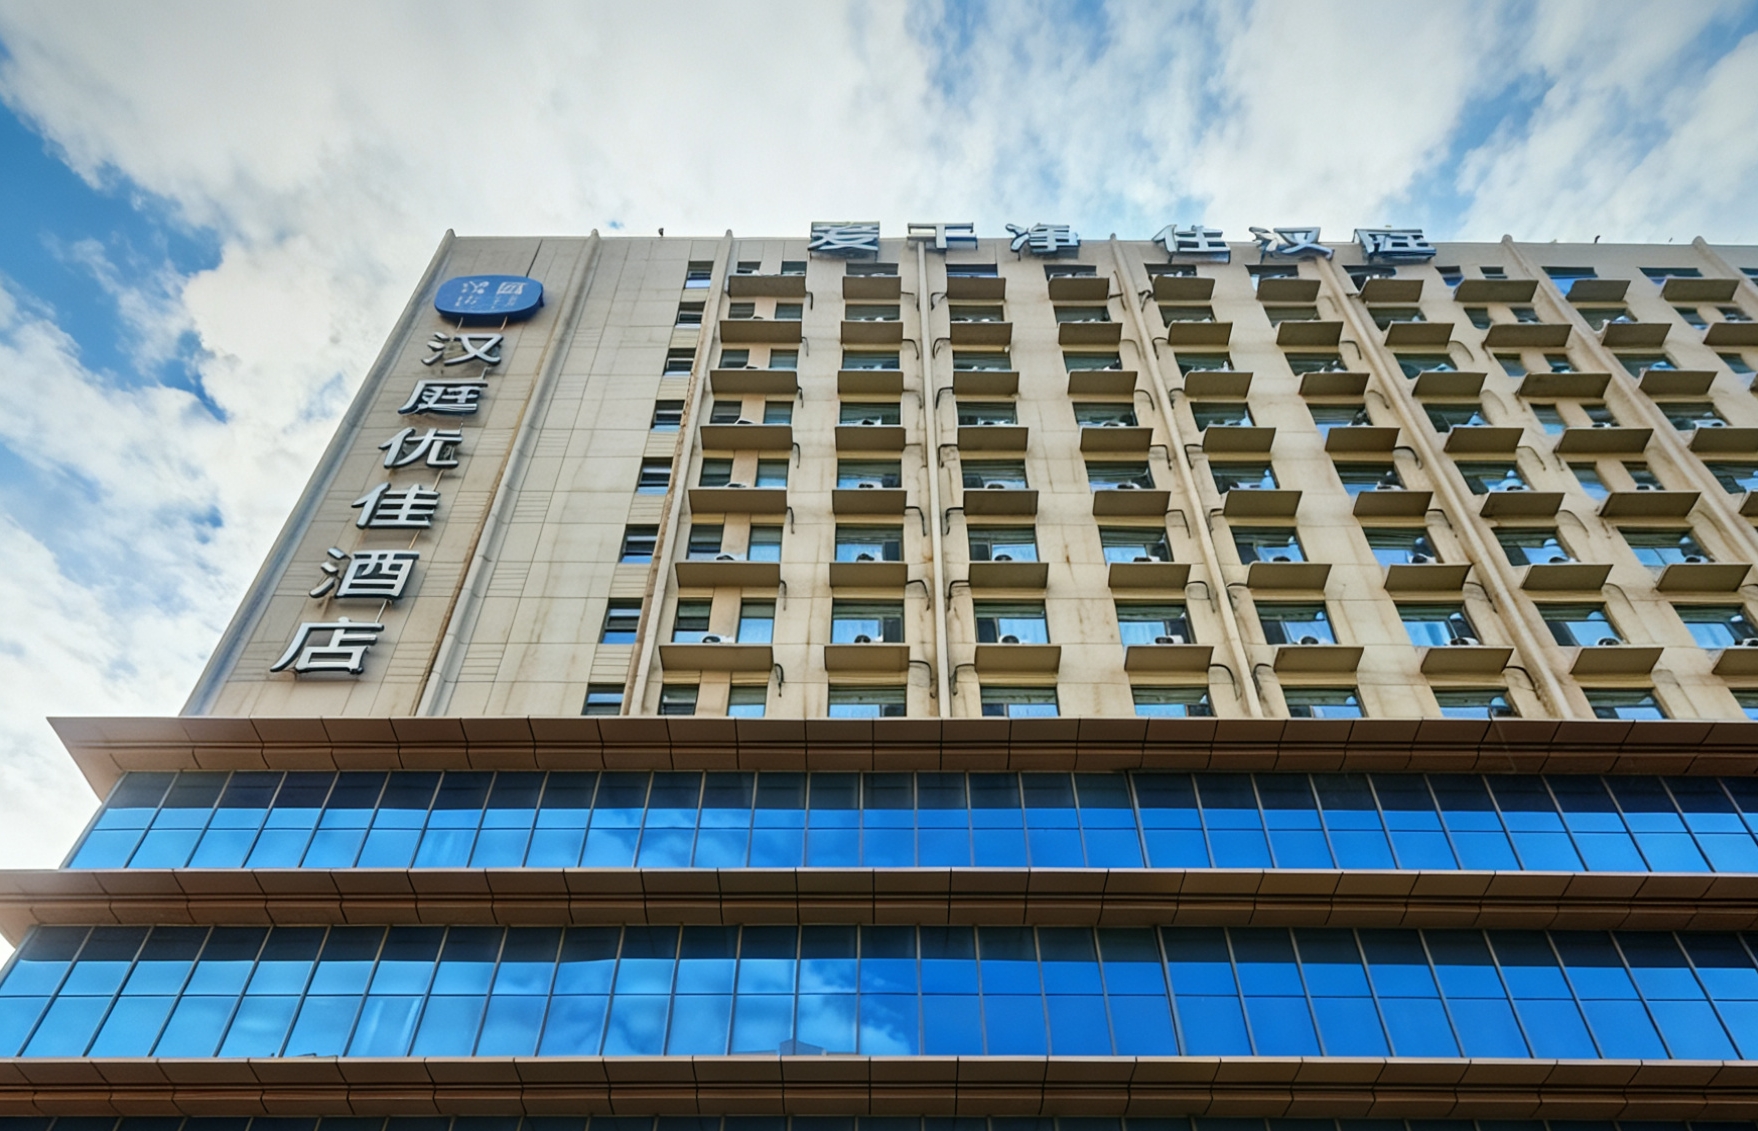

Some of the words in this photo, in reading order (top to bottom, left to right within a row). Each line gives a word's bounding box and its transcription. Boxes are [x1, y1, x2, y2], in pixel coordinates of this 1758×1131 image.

[270, 331, 505, 675] 汉庭优佳酒店
